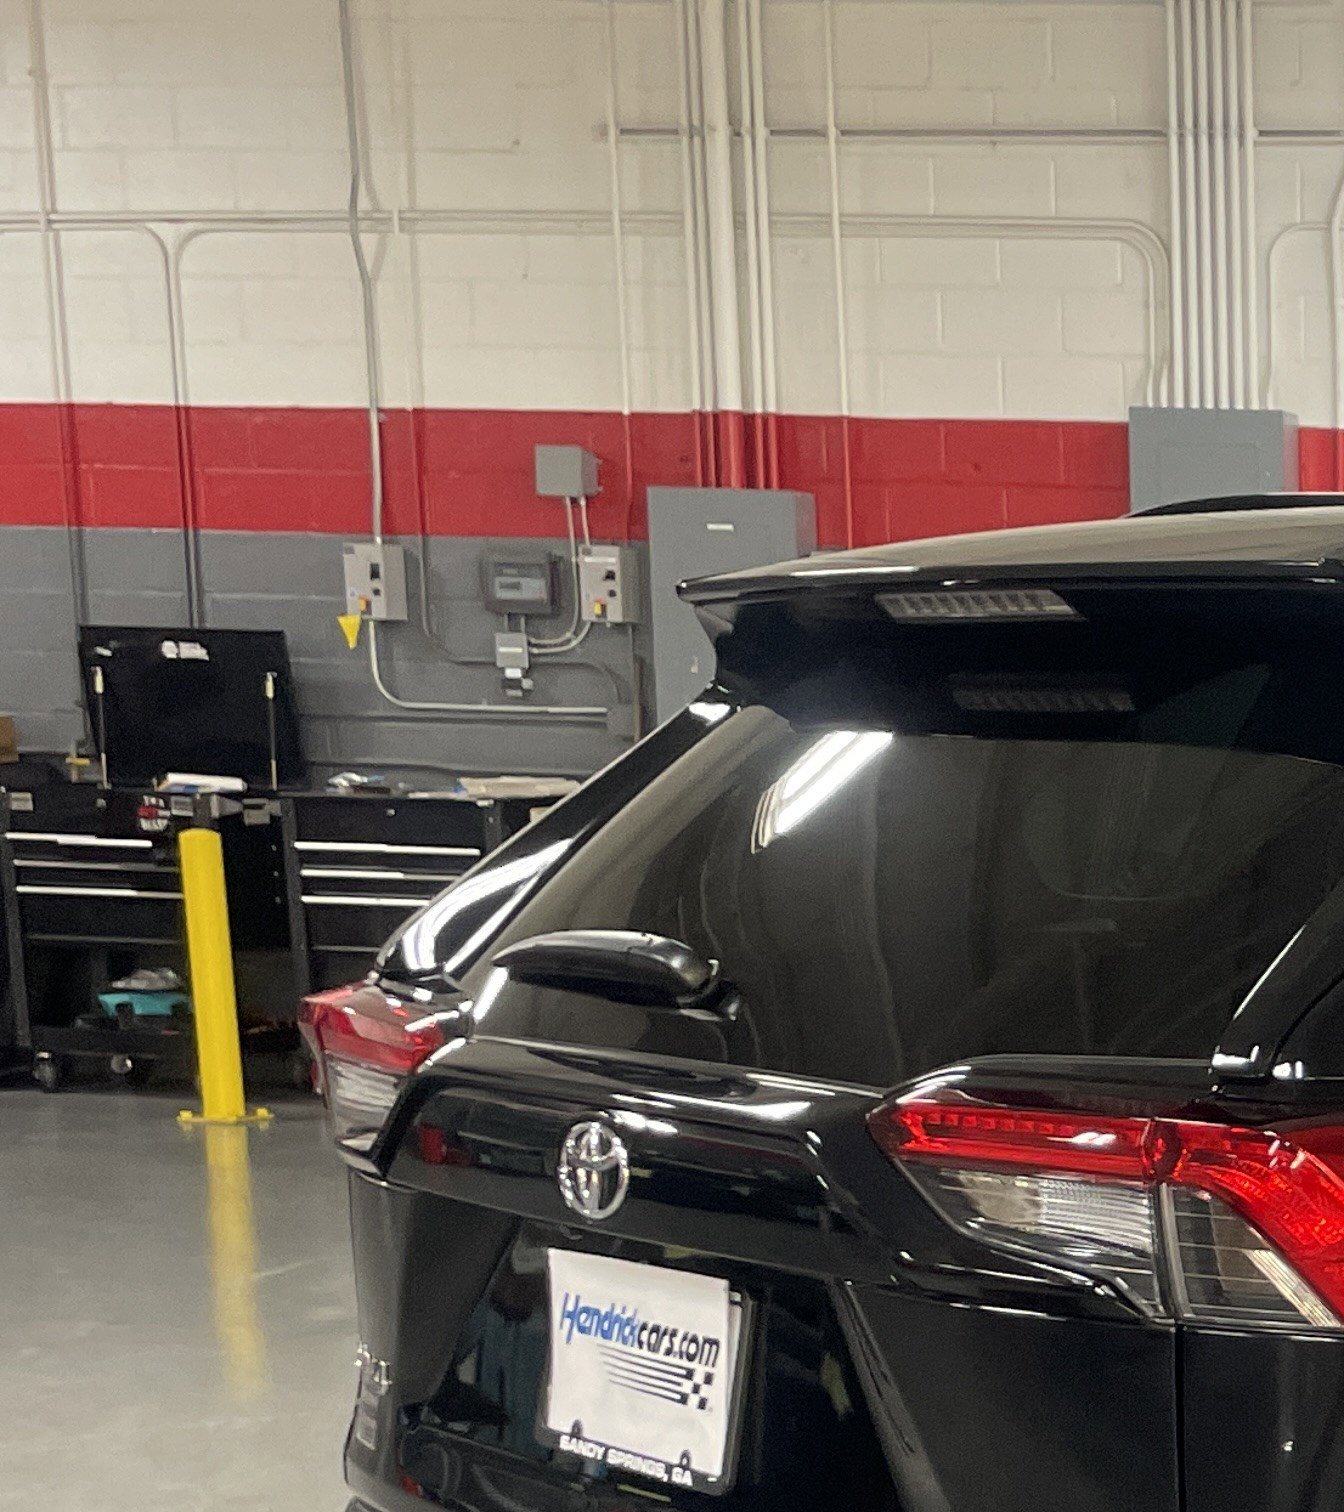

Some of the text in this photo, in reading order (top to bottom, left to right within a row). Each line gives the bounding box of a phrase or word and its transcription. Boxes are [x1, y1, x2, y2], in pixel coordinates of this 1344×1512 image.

[559, 1292, 720, 1367] Hendrickcars.com
[560, 1435, 605, 1460] SANDY
[671, 1466, 693, 1486] GA
